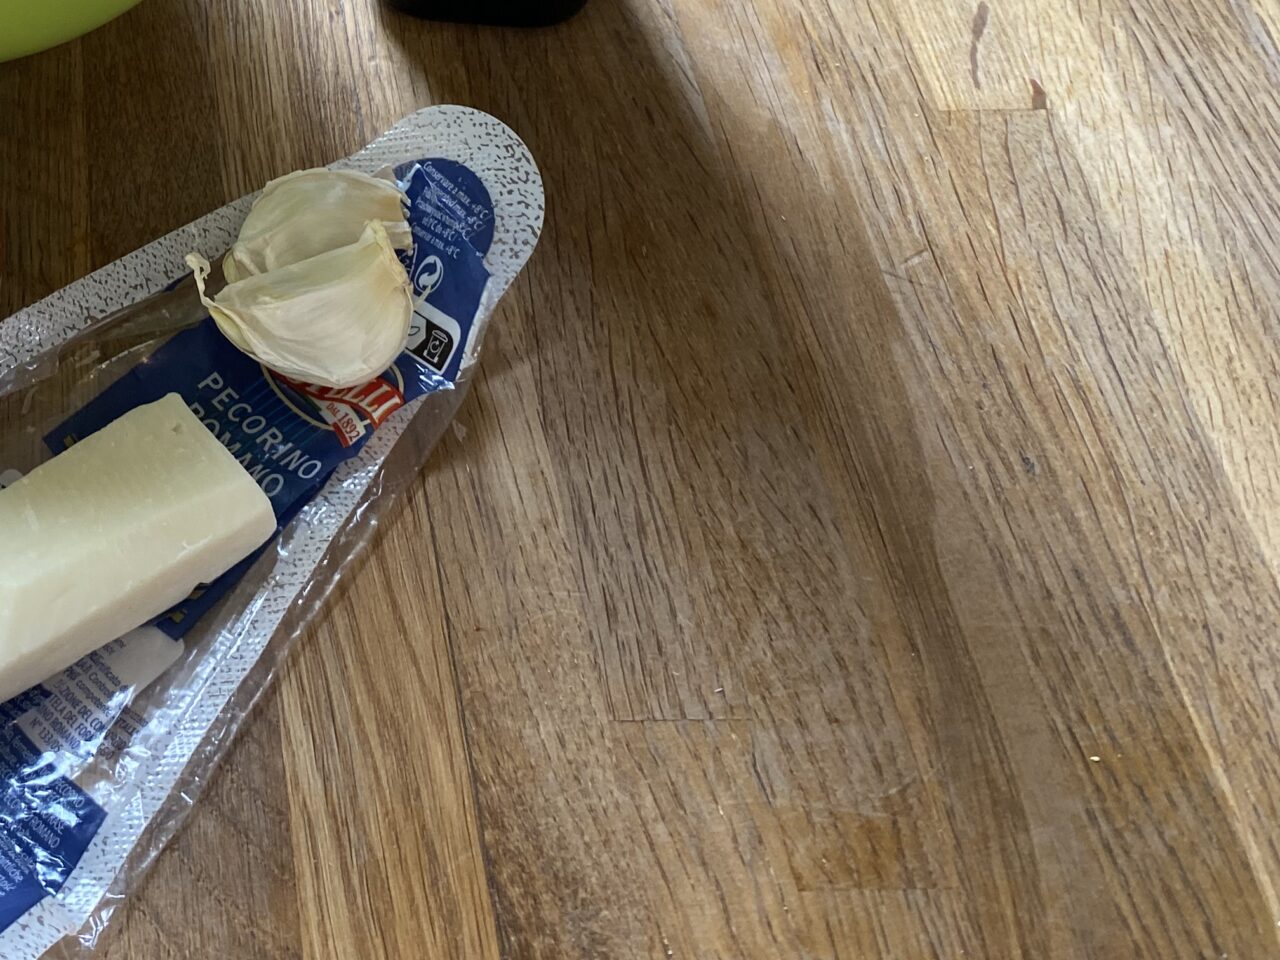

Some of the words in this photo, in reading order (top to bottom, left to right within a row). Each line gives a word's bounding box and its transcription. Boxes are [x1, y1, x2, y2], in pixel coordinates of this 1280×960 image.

[422, 160, 456, 191] Conservare
[455, 190, 473, 206] max.
[197, 371, 322, 480] PECORINO
[326, 402, 340, 417] DAL
[339, 412, 360, 442] 1892
[62, 710, 78, 727] DEL
[77, 704, 94, 722] DEL
[49, 716, 81, 750] ROMANO
[28, 816, 61, 848] ROMANO
